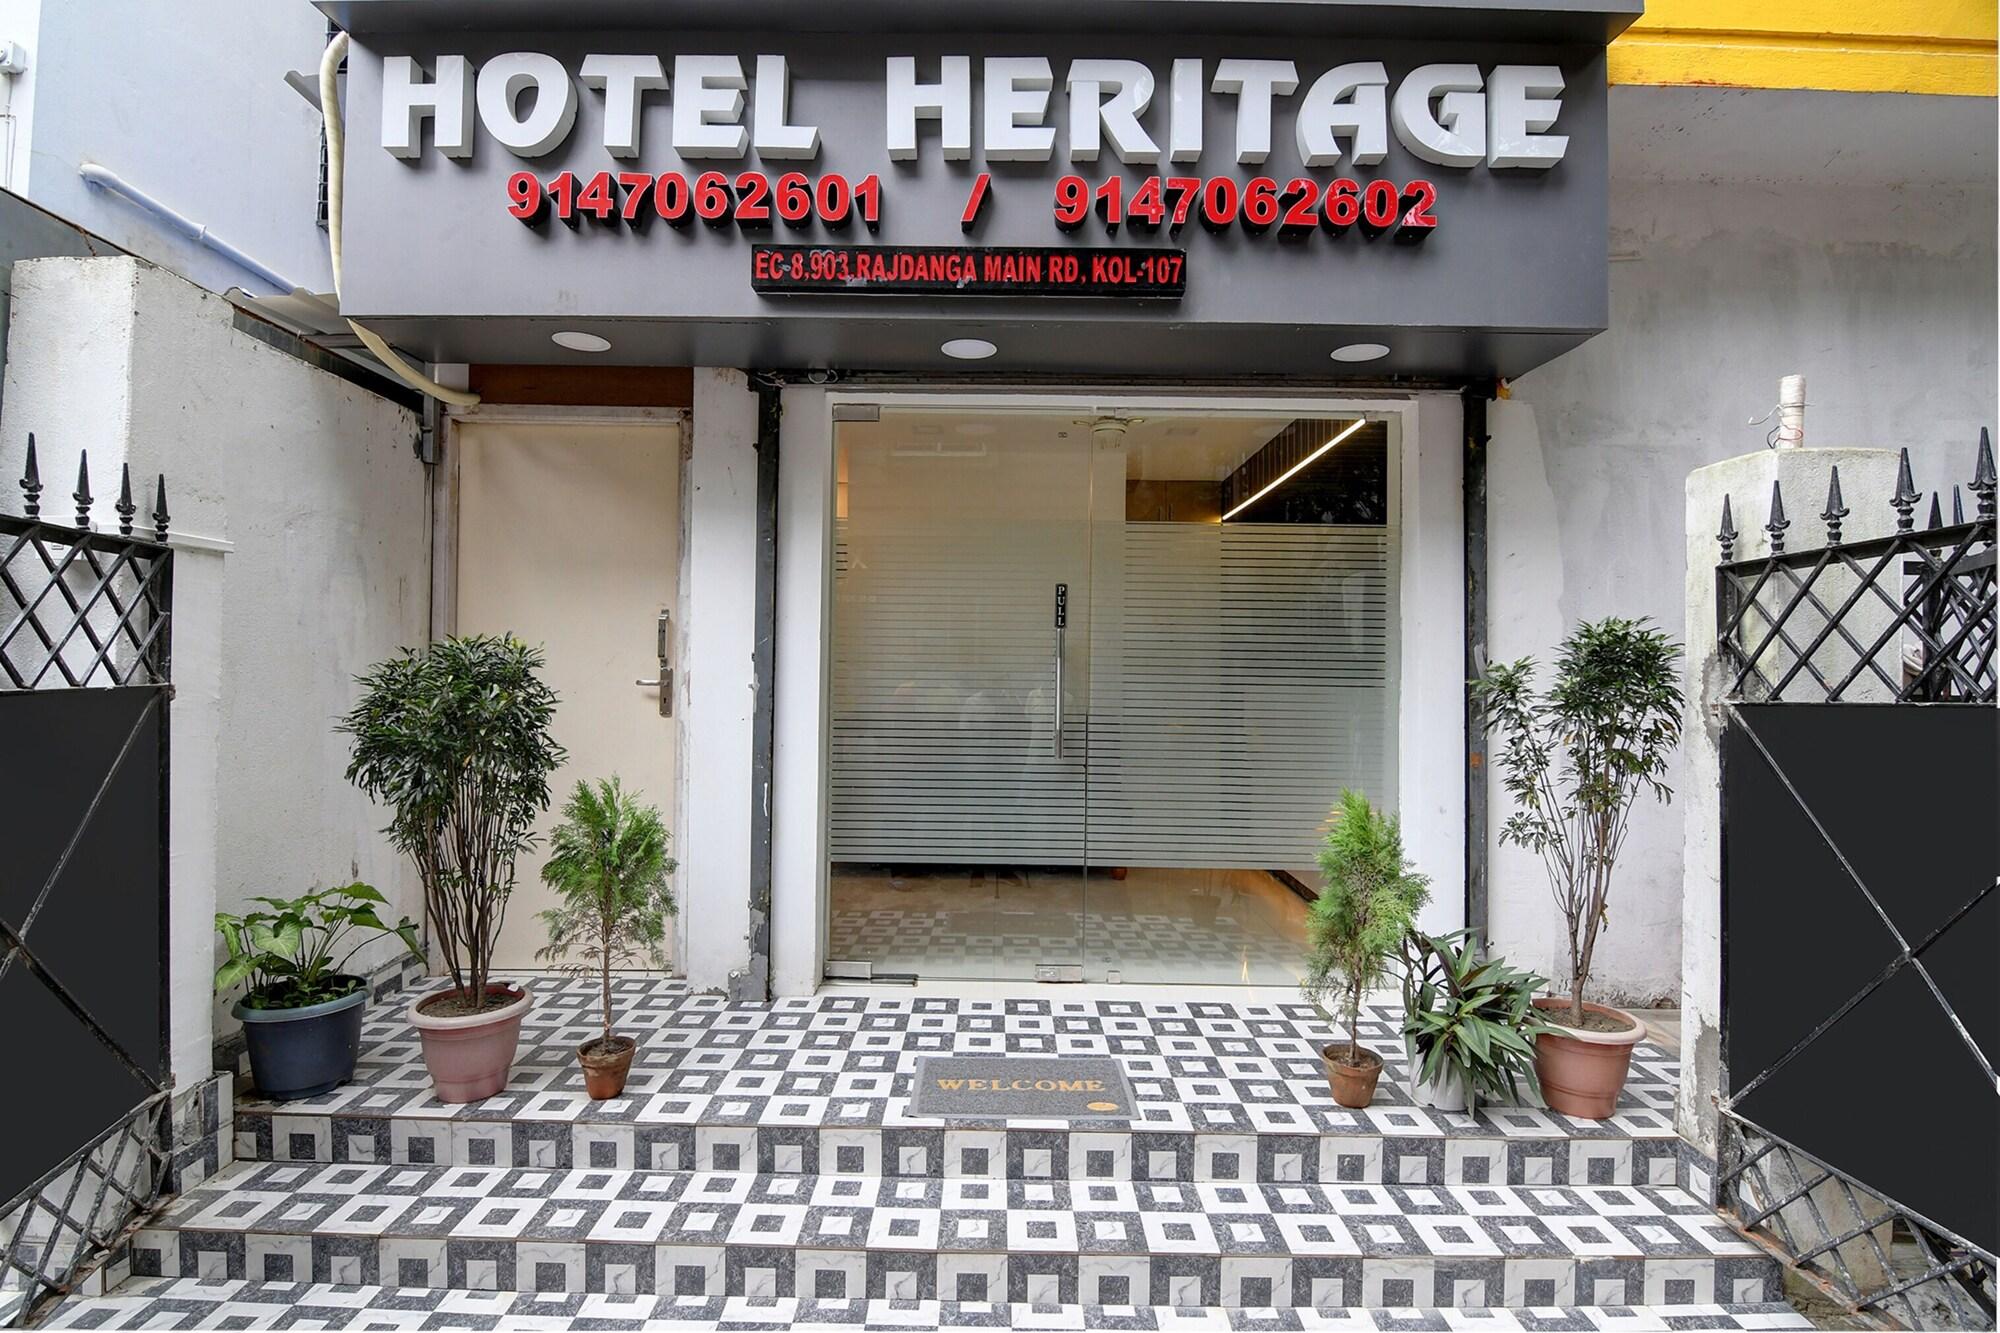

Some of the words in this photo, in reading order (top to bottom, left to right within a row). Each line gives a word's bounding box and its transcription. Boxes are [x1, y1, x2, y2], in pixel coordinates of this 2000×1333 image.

[381, 52, 820, 160] HOTEL
[886, 56, 1570, 168] HERITAGE
[507, 171, 880, 226] 9147062601
[961, 173, 991, 226] /
[1054, 175, 1439, 232] 9147062602
[984, 255, 1041, 283] MAIN
[1092, 257, 1183, 284] KOL-107
[1057, 585, 1065, 626] PULL
[936, 1078, 1106, 1092] WELCOME
